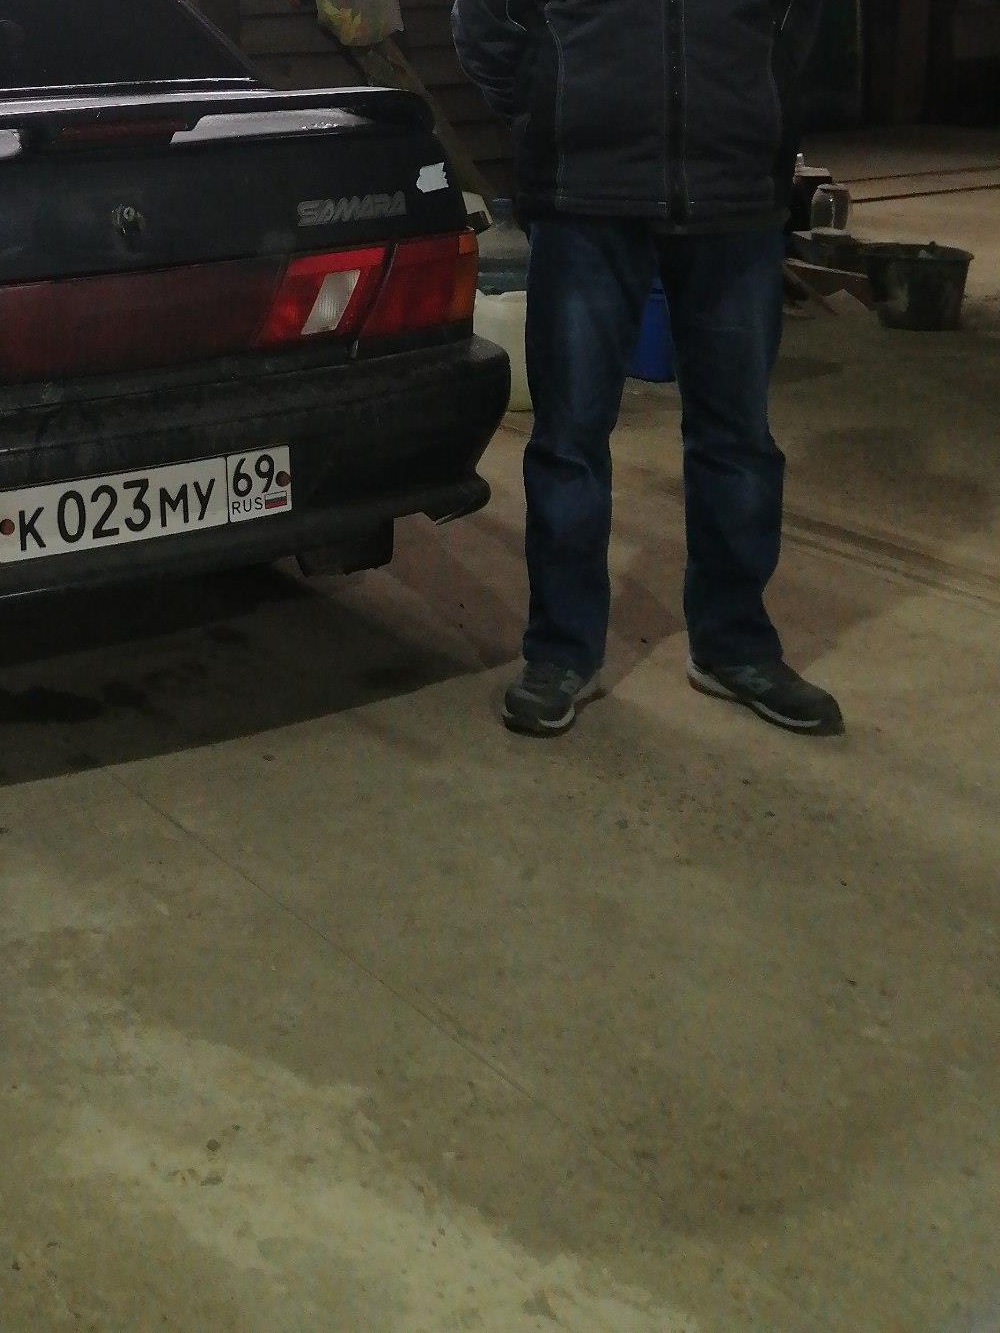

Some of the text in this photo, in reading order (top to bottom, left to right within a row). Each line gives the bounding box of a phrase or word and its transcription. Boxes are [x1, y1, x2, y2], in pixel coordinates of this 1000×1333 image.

[18, 454, 275, 551] К023МУ 69
[232, 497, 264, 515] RUS
